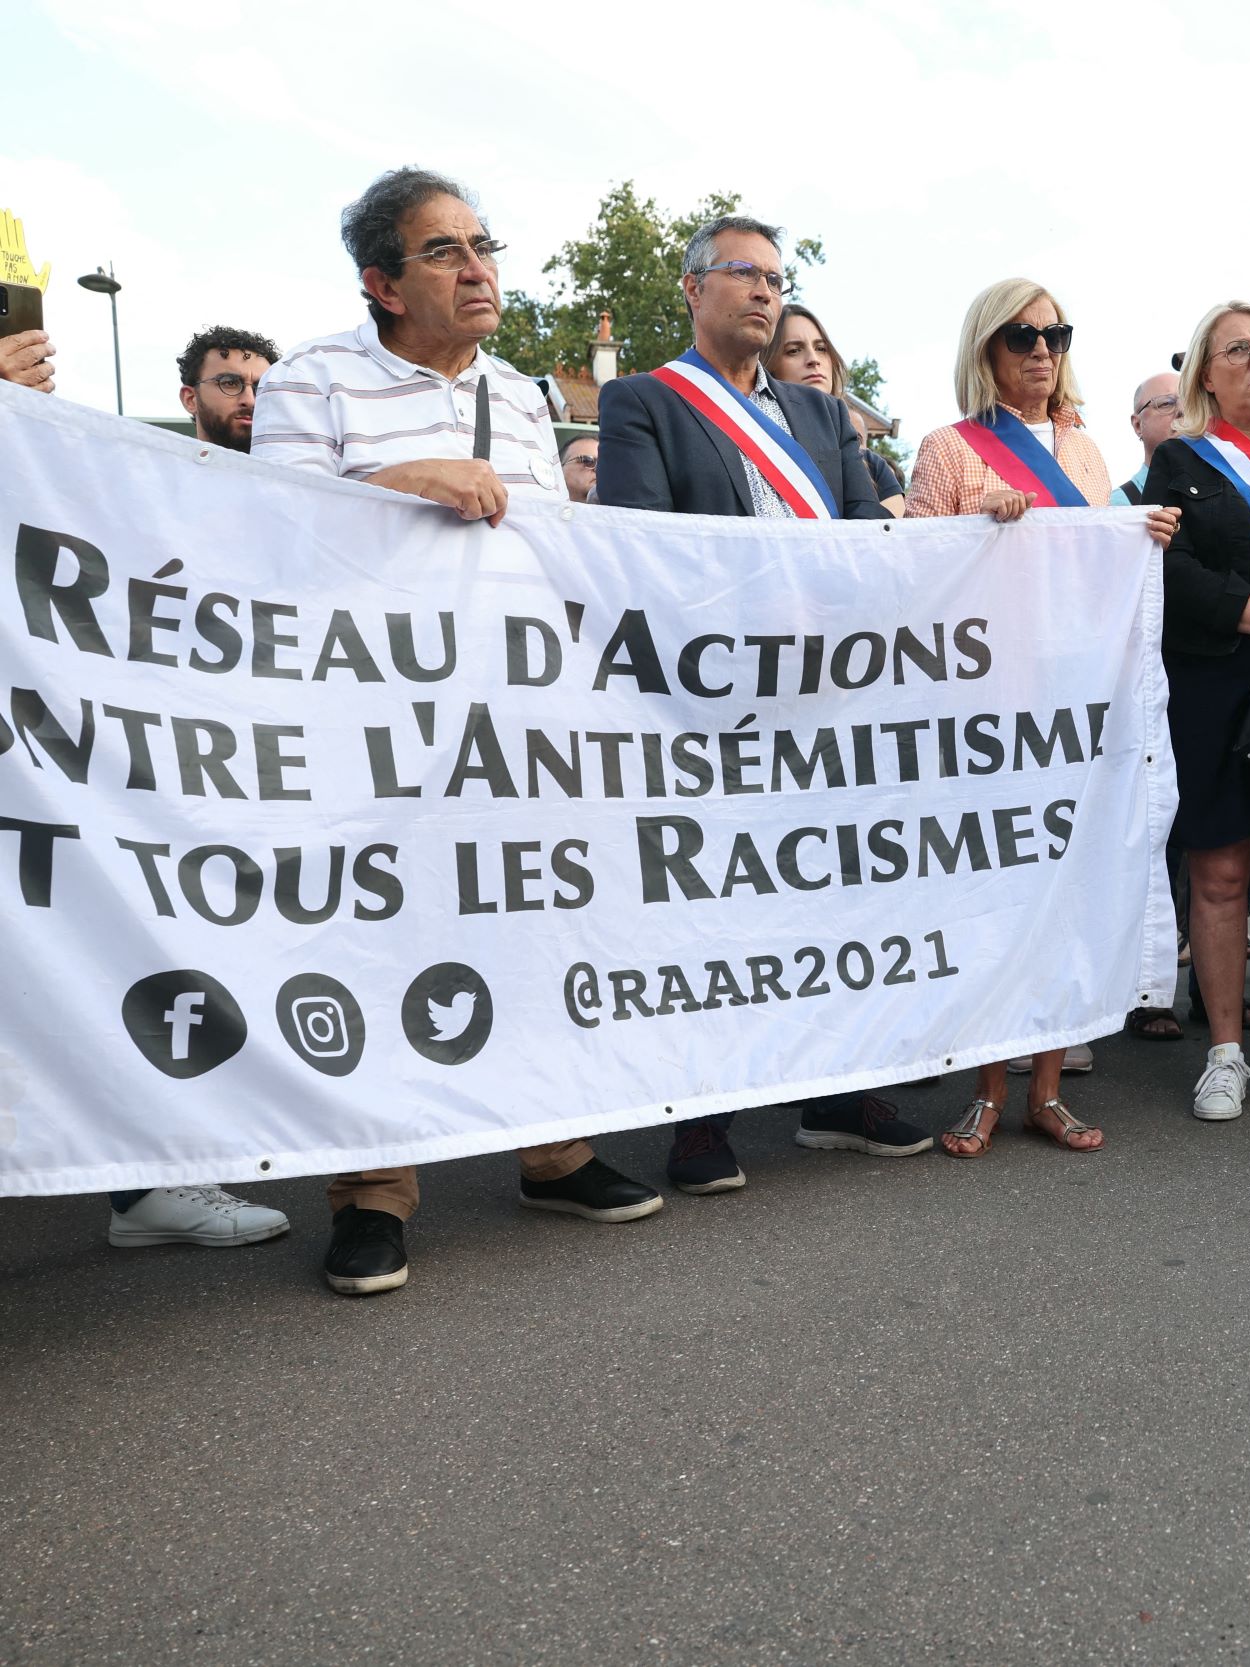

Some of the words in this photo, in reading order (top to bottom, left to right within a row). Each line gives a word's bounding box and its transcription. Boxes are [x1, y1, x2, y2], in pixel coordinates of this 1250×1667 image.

[1, 250, 26, 263] TOUCHE
[4, 261, 18, 274] PAS
[14, 522, 457, 683] RÉSEAU
[505, 600, 993, 698] D'ACTIONS
[115, 836, 405, 927] TOUS
[455, 838, 595, 916] LES
[635, 799, 1077, 904] RACISMES
